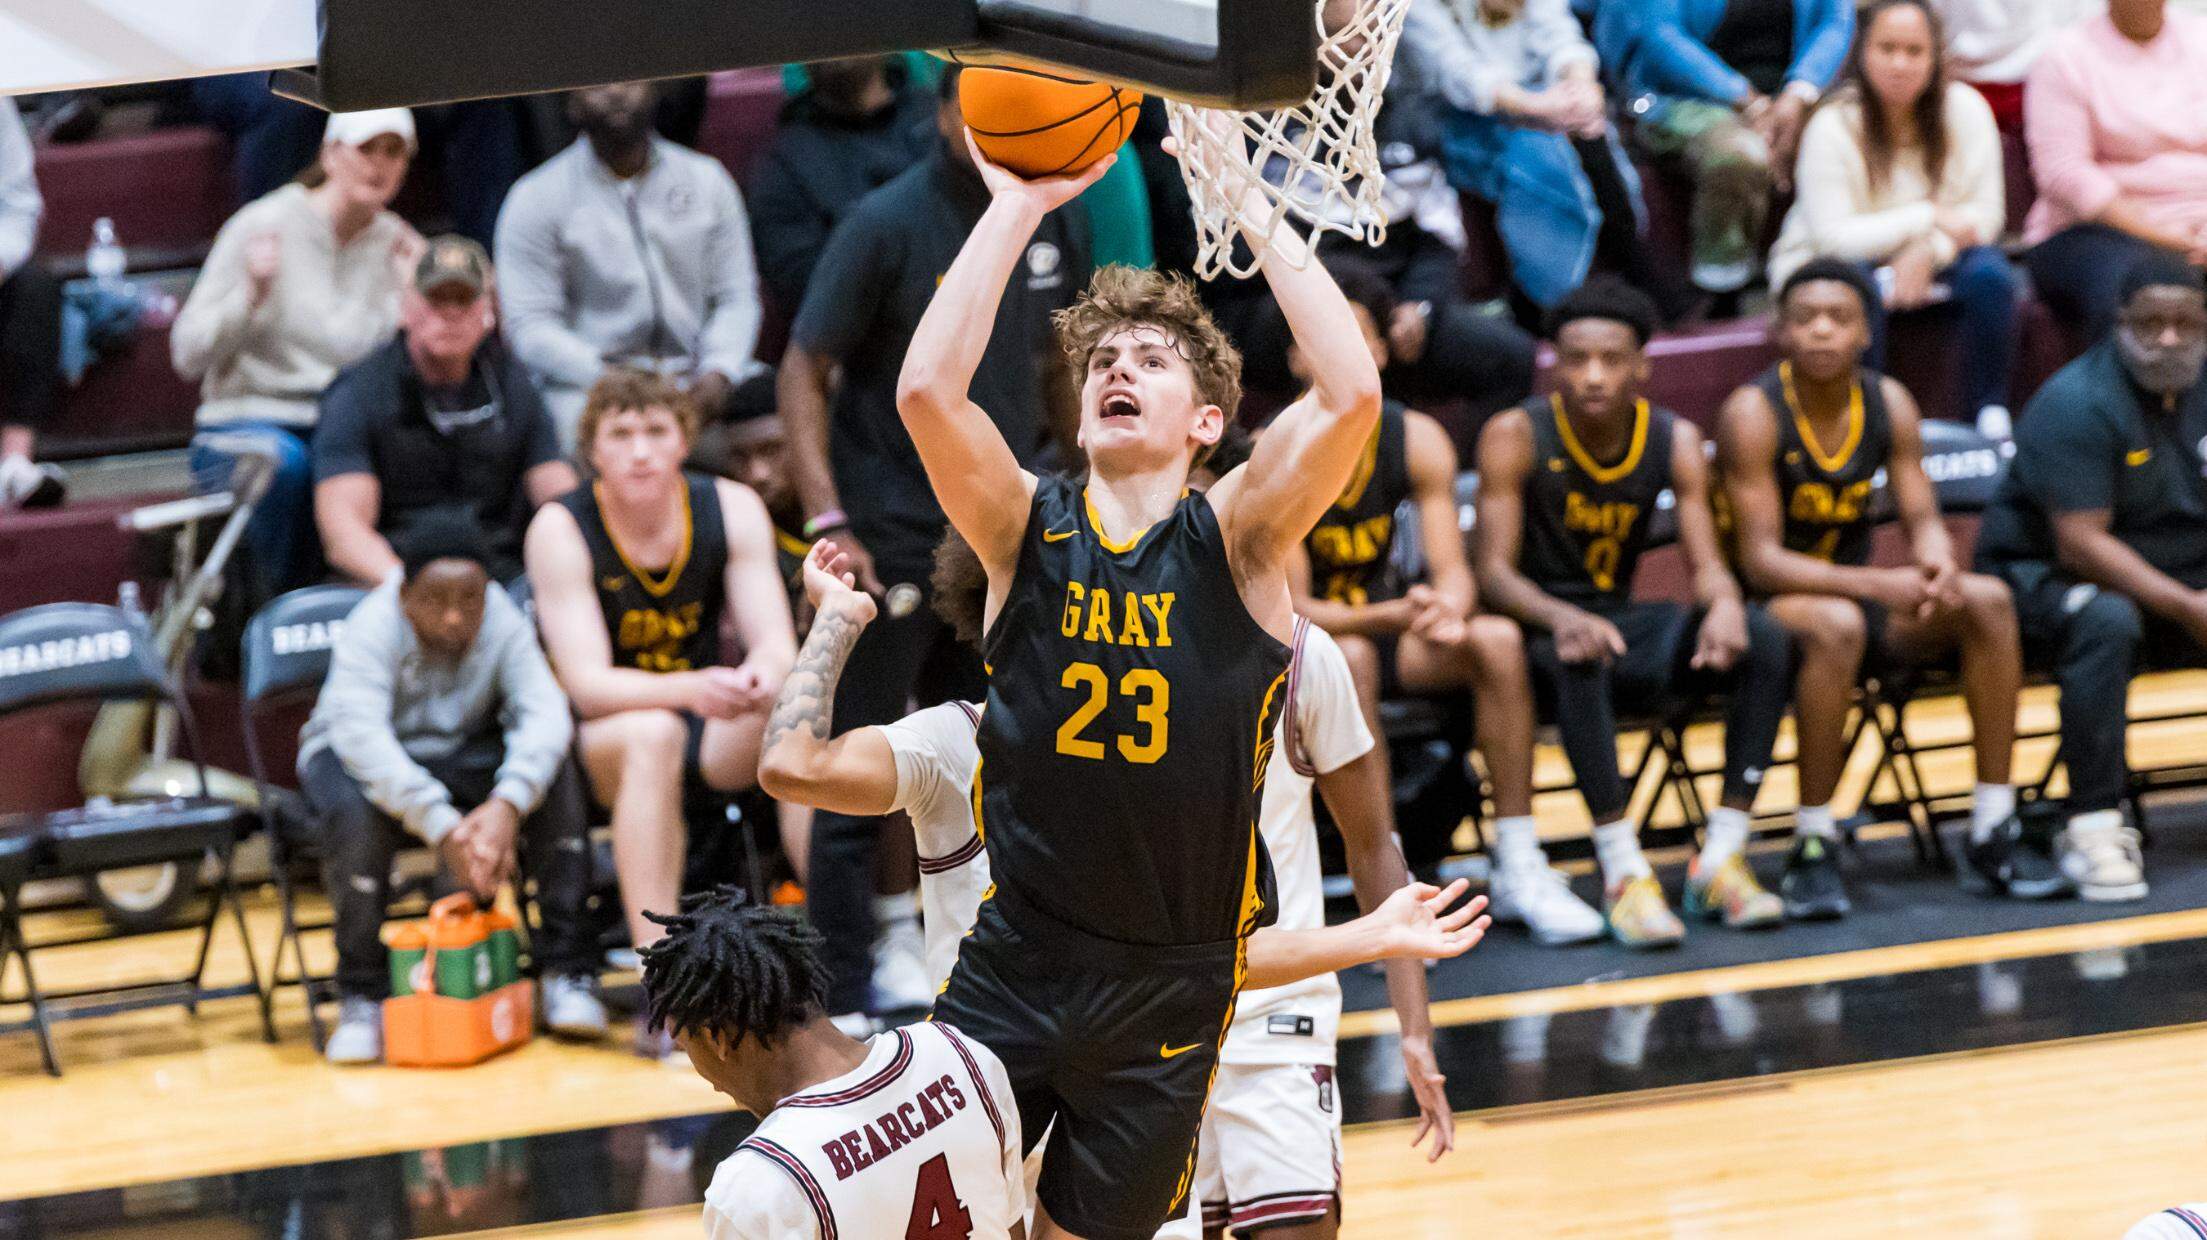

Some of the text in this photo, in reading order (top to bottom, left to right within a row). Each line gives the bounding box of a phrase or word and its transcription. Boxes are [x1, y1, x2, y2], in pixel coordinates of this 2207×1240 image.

[0, 630, 132, 676] EARCATS
[1061, 581, 1176, 648] GRAY
[1056, 661, 1170, 764] 23
[821, 1074, 967, 1181] BEARCATS
[904, 1151, 974, 1240] 4
